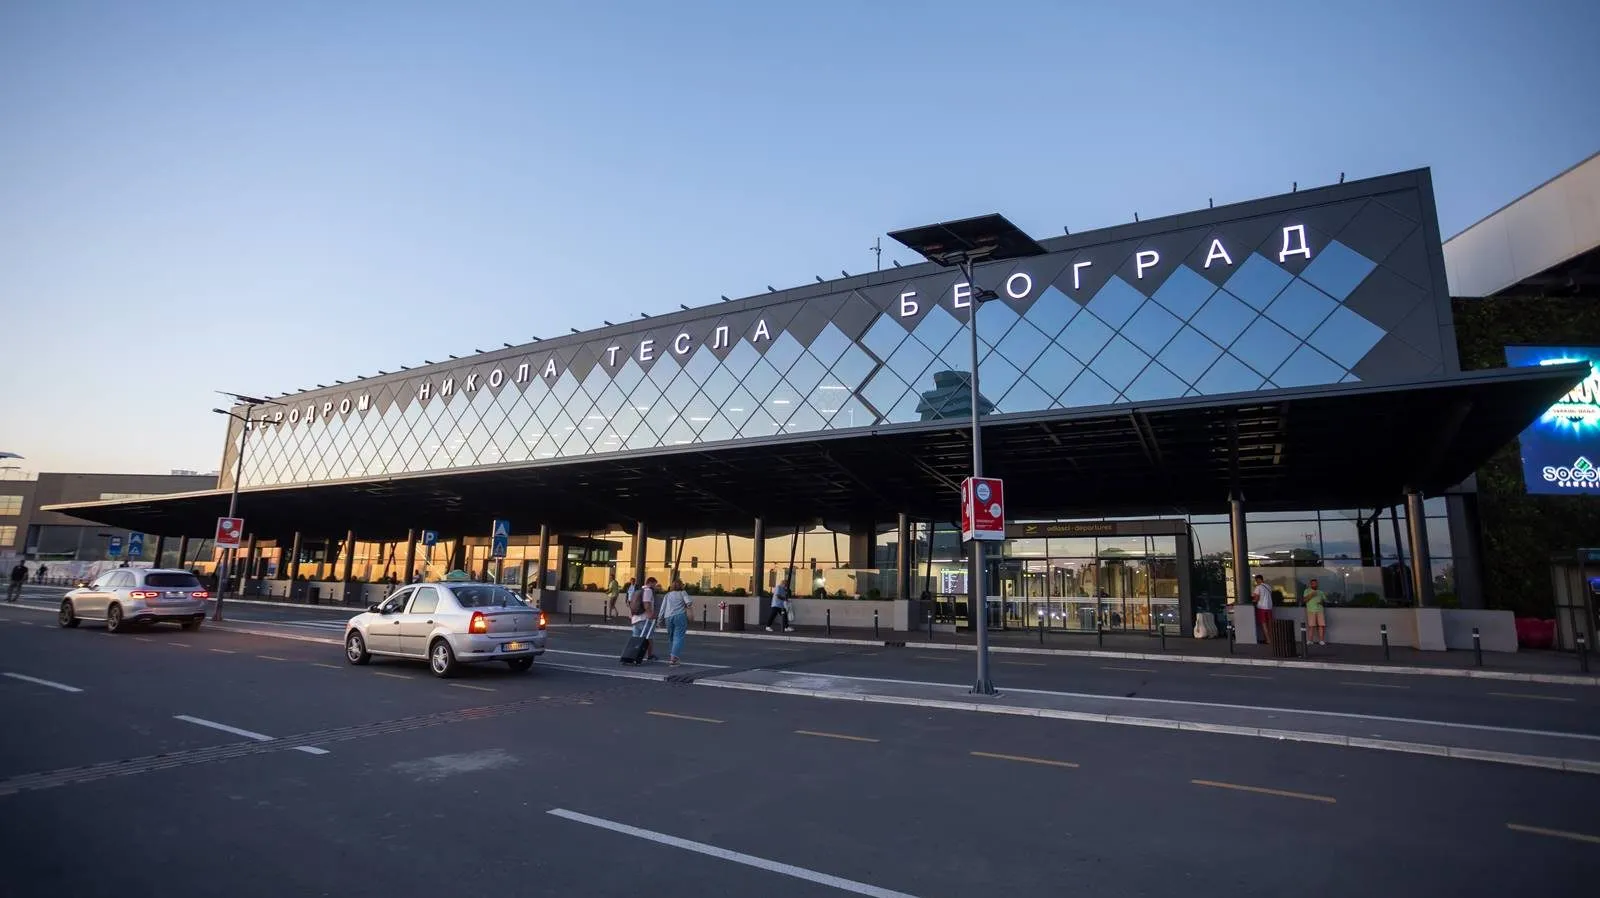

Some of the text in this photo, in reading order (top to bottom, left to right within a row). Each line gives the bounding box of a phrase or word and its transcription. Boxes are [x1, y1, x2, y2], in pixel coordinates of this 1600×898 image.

[419, 359, 557, 400] НИКОЛА
[607, 320, 770, 366] ТЕСЛА
[900, 224, 1311, 317] БЕОГРАД
[1074, 523, 1112, 533] departures
[425, 532, 434, 543] P
